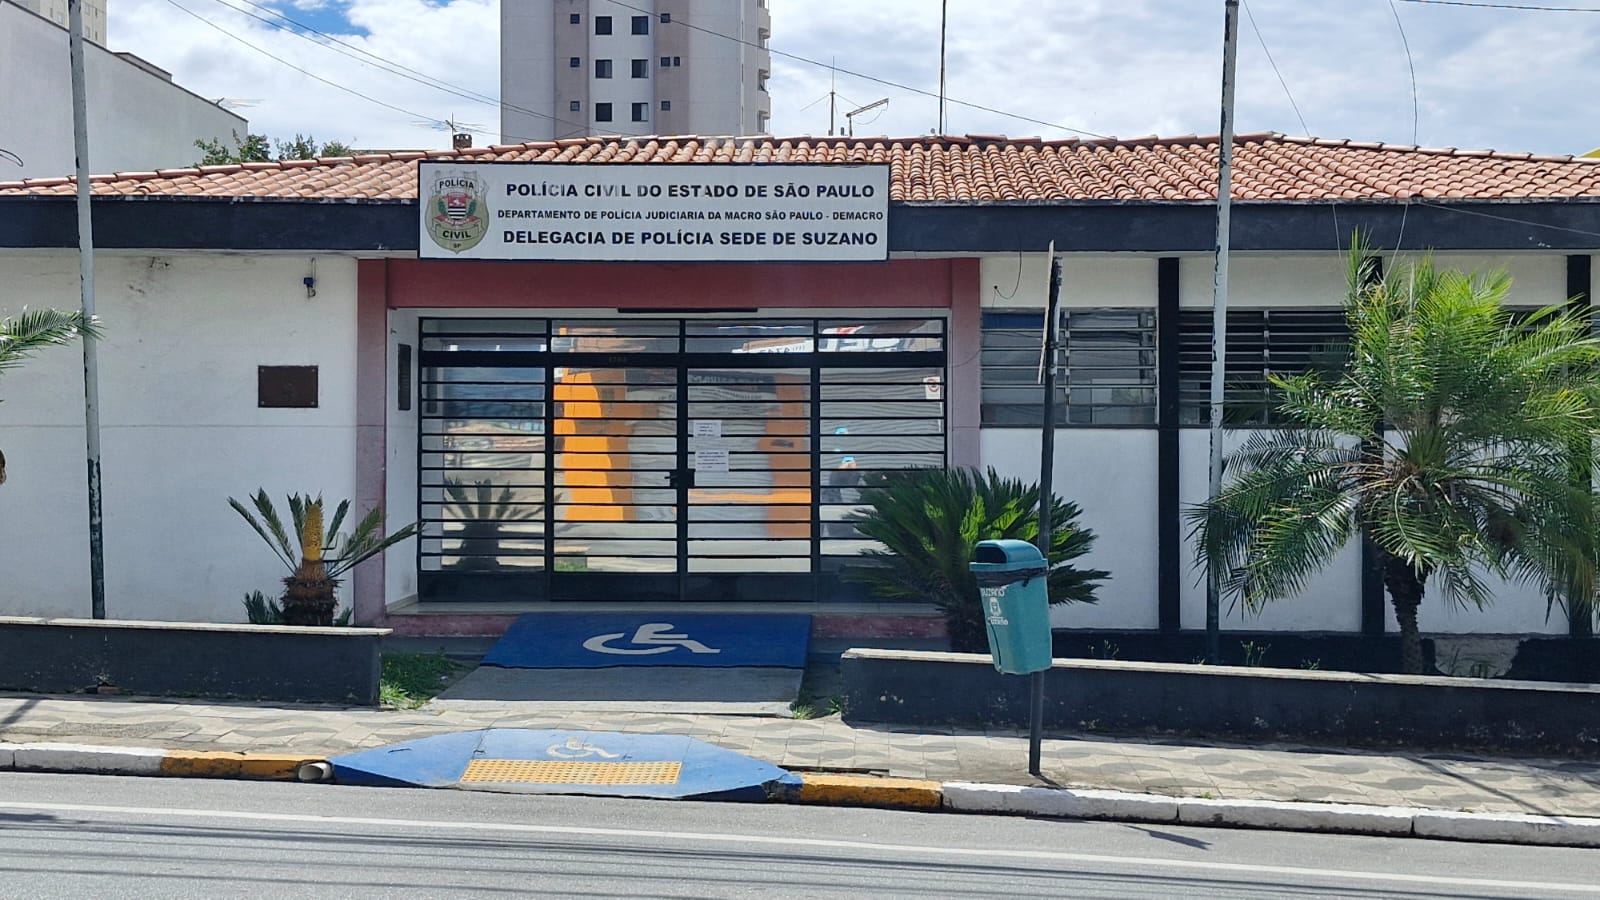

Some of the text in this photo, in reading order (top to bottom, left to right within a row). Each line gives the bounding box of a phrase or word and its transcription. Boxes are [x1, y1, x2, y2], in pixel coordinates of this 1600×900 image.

[506, 181, 875, 198] POLÍCIA CIVIL DO ESTADO DE SÃO PAULO
[497, 209, 581, 220] DEPARTAMENTO
[584, 210, 598, 220] DE
[600, 208, 643, 220] POLÍCIA
[645, 210, 706, 221] JUDICIARIA
[707, 210, 722, 221] DA
[724, 210, 763, 221] MACRO
[764, 209, 787, 221] SÃO
[789, 210, 824, 221] PAULO
[832, 211, 884, 221] DEMACRO
[442, 230, 472, 239] CIVIL
[503, 229, 878, 246] DELEGACIA DE POLÍCIA SEDE DE SUZANO
